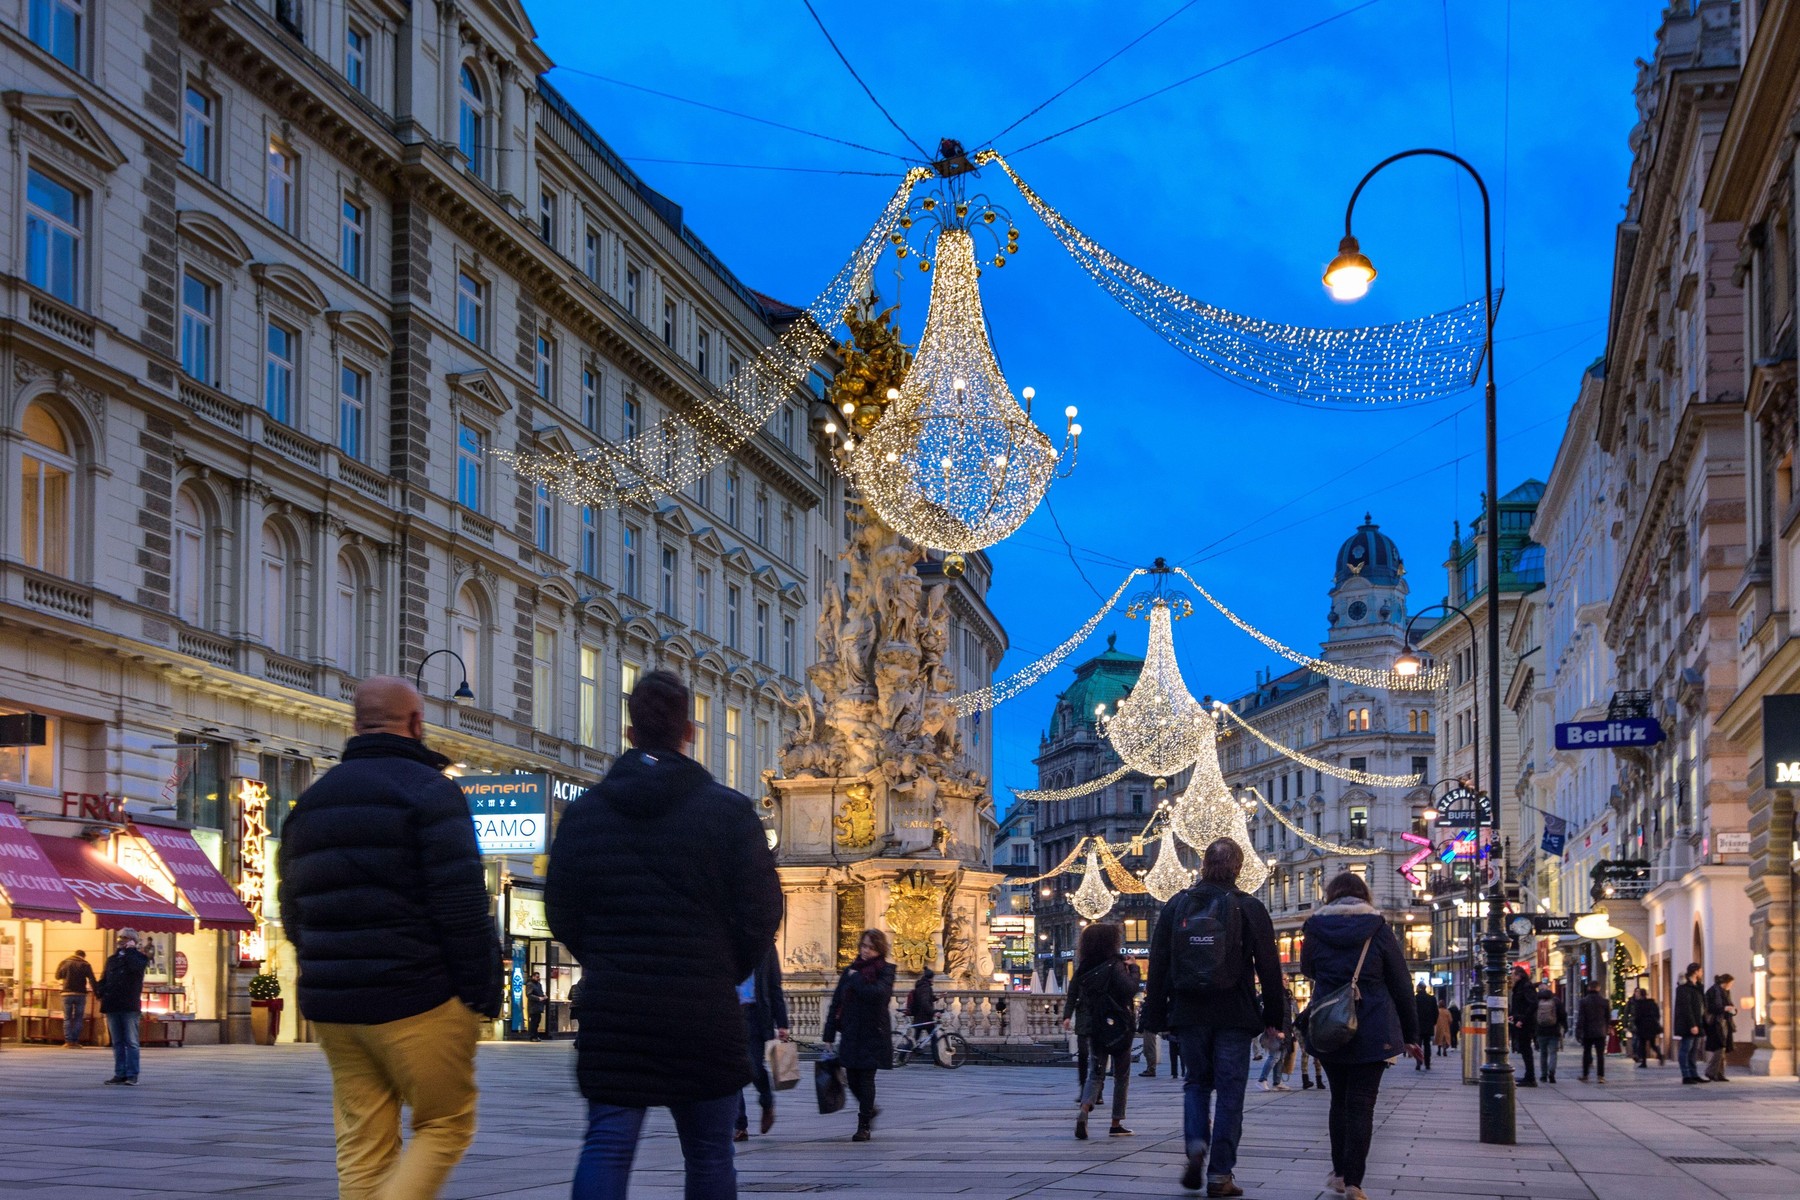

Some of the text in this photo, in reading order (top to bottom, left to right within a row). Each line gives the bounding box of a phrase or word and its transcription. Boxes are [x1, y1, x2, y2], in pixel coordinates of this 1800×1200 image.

[1567, 723, 1647, 744] Berlitz
[460, 782, 538, 795] wienerin
[1448, 811, 1476, 820] BUFFE
[167, 861, 217, 879] BOOKS
[1548, 919, 1569, 928] IWC
